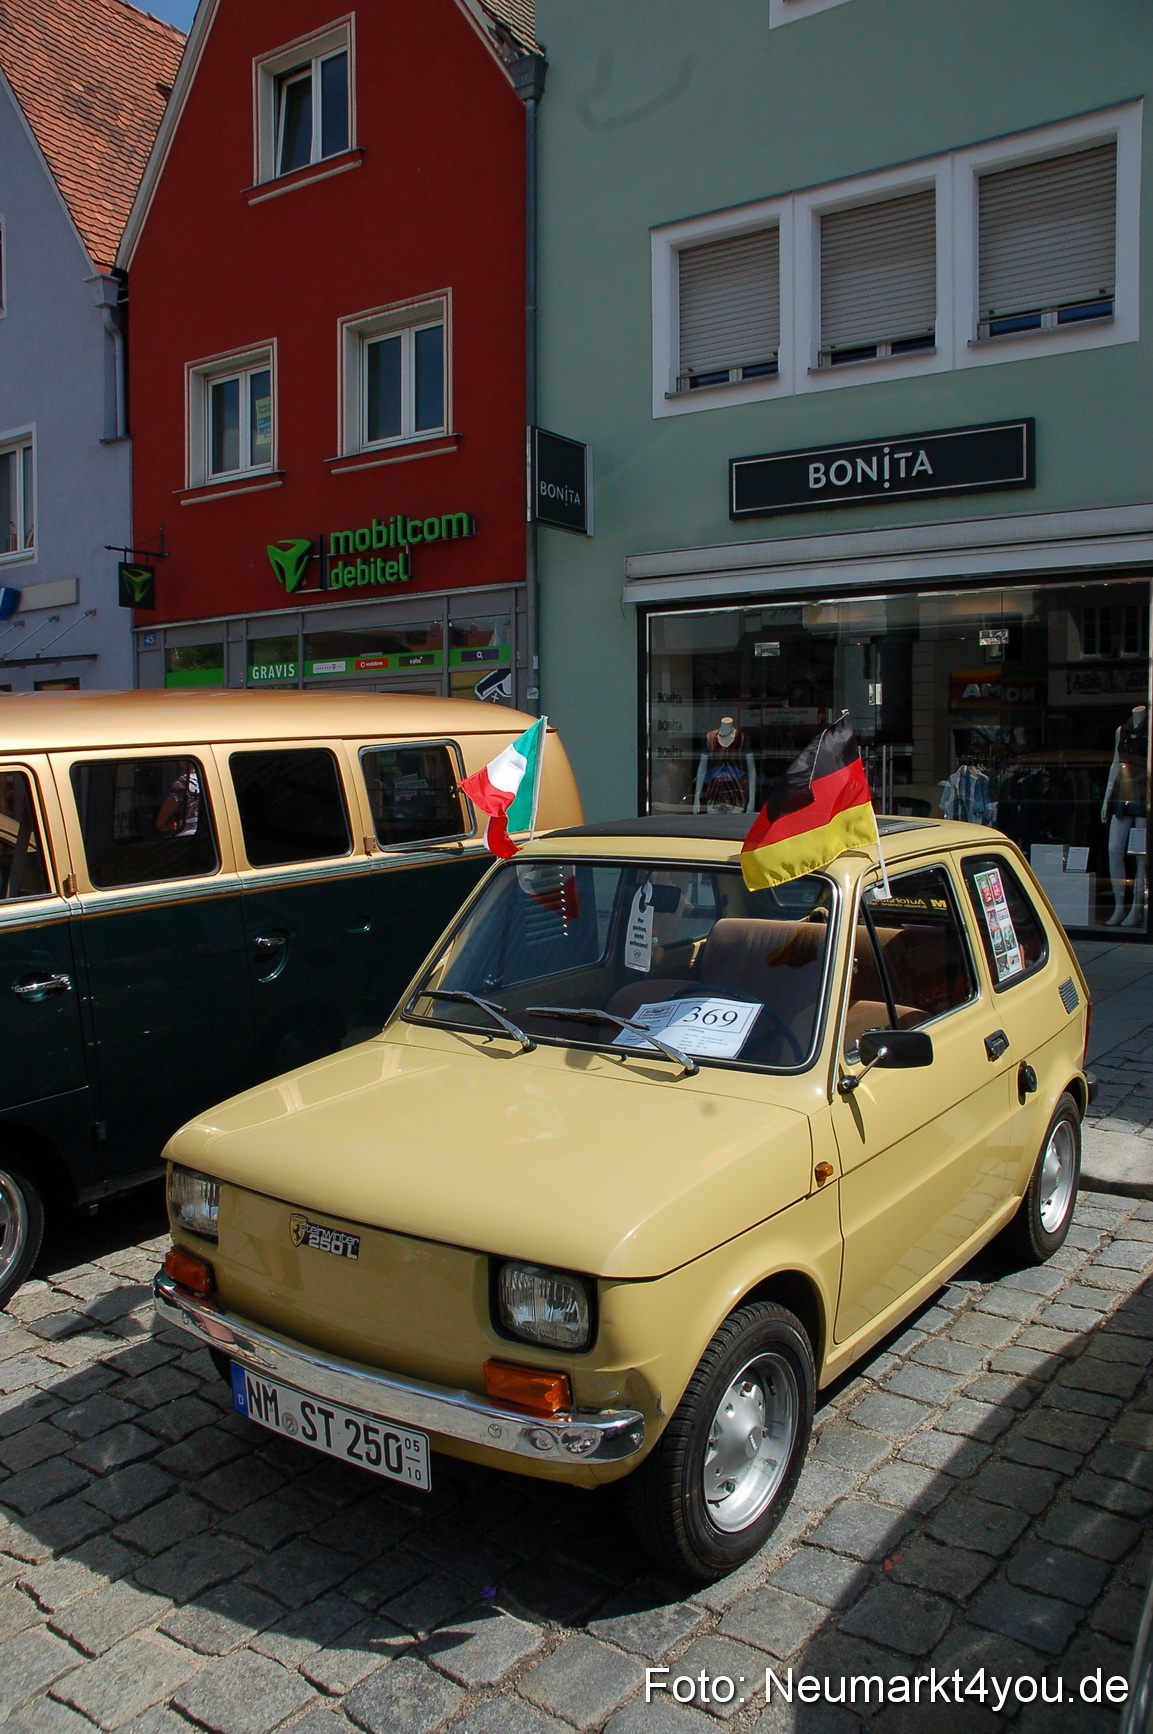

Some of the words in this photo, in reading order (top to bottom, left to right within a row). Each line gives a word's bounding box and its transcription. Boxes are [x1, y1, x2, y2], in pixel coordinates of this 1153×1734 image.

[330, 512, 470, 555] mobilcom
[330, 552, 410, 588] debitel
[145, 634, 155, 644] 45
[252, 663, 296, 680] GRAVIS
[682, 1006, 738, 1028] 369
[300, 1223, 360, 1246] steinwinter
[308, 1234, 343, 1255] 250
[346, 1243, 358, 1260] L
[238, 1393, 244, 1406] D
[246, 1376, 280, 1427] NM
[300, 1400, 335, 1449] ST
[344, 1418, 404, 1475] 250
[404, 1437, 420, 1453] 05
[406, 1466, 422, 1482] 10
